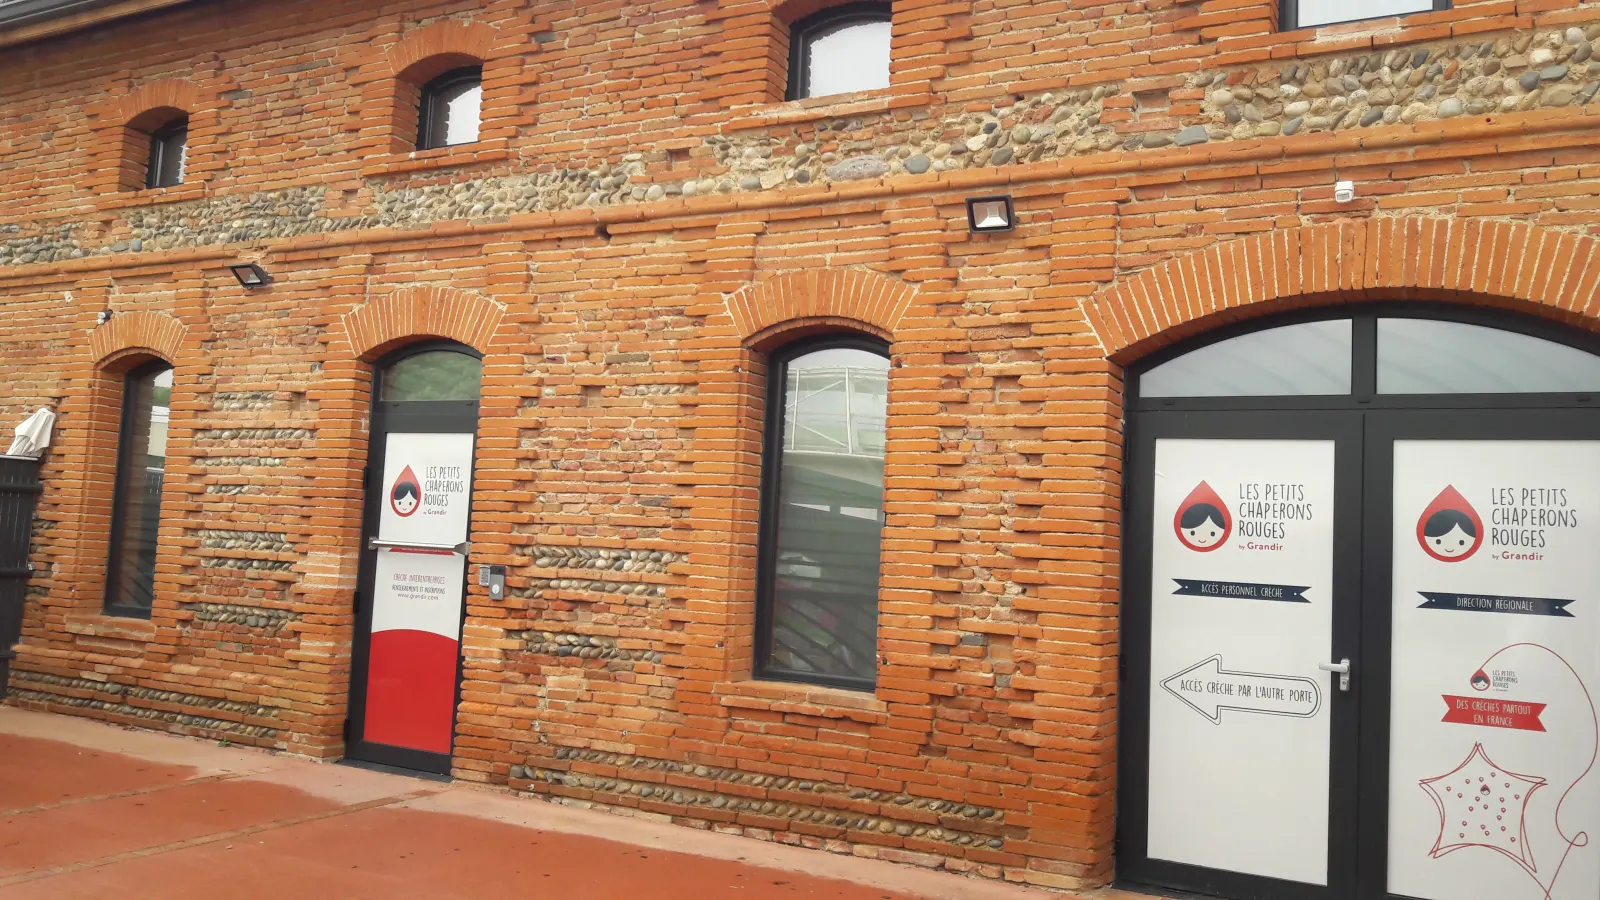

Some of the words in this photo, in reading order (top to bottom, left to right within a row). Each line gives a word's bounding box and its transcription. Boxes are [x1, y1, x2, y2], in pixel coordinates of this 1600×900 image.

[426, 466, 437, 479] LES
[440, 466, 460, 479] PETITS
[425, 480, 463, 493] CHAPERONS
[1239, 483, 1259, 500] LES
[1265, 484, 1304, 501] PETITS
[424, 493, 449, 506] ROUGES
[1491, 487, 1514, 506] LES
[1522, 488, 1567, 507] PETITS
[1239, 501, 1313, 520] CHAPERONS
[1491, 507, 1578, 528] CHAPERONS
[1238, 520, 1285, 539] ROUGES
[1491, 527, 1546, 548] ROUGES
[1247, 542, 1283, 551] Grandir
[1501, 551, 1544, 561] Grandir
[1201, 583, 1219, 594] ACCÈS
[1221, 585, 1258, 596] PERSONNEL
[1260, 586, 1283, 598] CRÈCHE
[1456, 597, 1493, 609] DIRECTION
[1495, 598, 1534, 611] RÉGIONALE
[1180, 678, 1203, 692] ACCÈS
[1206, 680, 1234, 695] CRÈCHE
[1238, 684, 1252, 697] PAR
[1255, 686, 1285, 701] L'AUTRE
[1289, 689, 1313, 703] PORTE
[1456, 699, 1469, 710] DES
[1471, 700, 1500, 713] CRÈCHES
[1502, 703, 1532, 715] PARTOUT
[1473, 714, 1484, 724] EN
[1487, 715, 1513, 727] FRANCE
